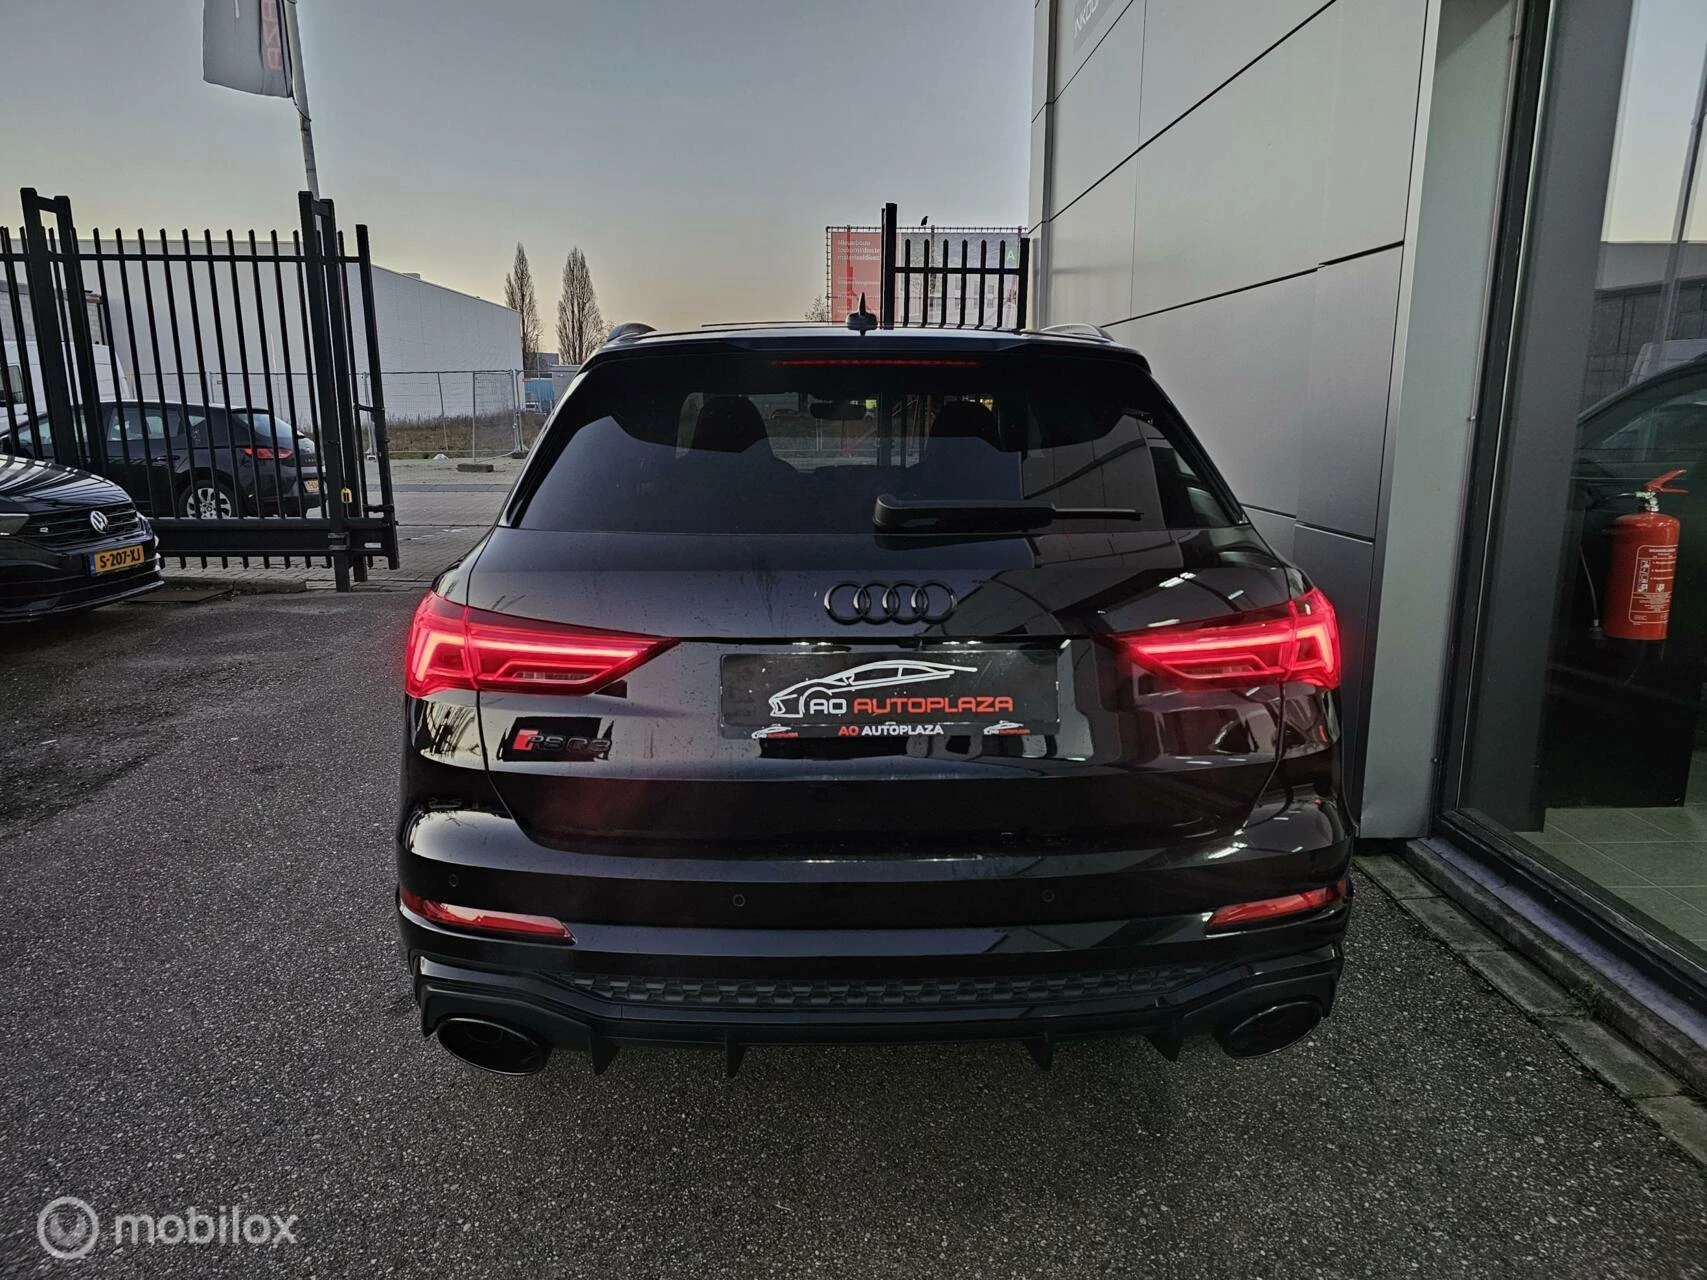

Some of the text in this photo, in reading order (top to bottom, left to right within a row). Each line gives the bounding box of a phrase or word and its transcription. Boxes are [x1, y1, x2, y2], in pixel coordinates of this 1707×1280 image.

[100, 549, 141, 569] S-207-XJ
[810, 696, 1014, 715] AO AUTOPLAZA
[838, 724, 944, 737] AO AUTOPLAZA
